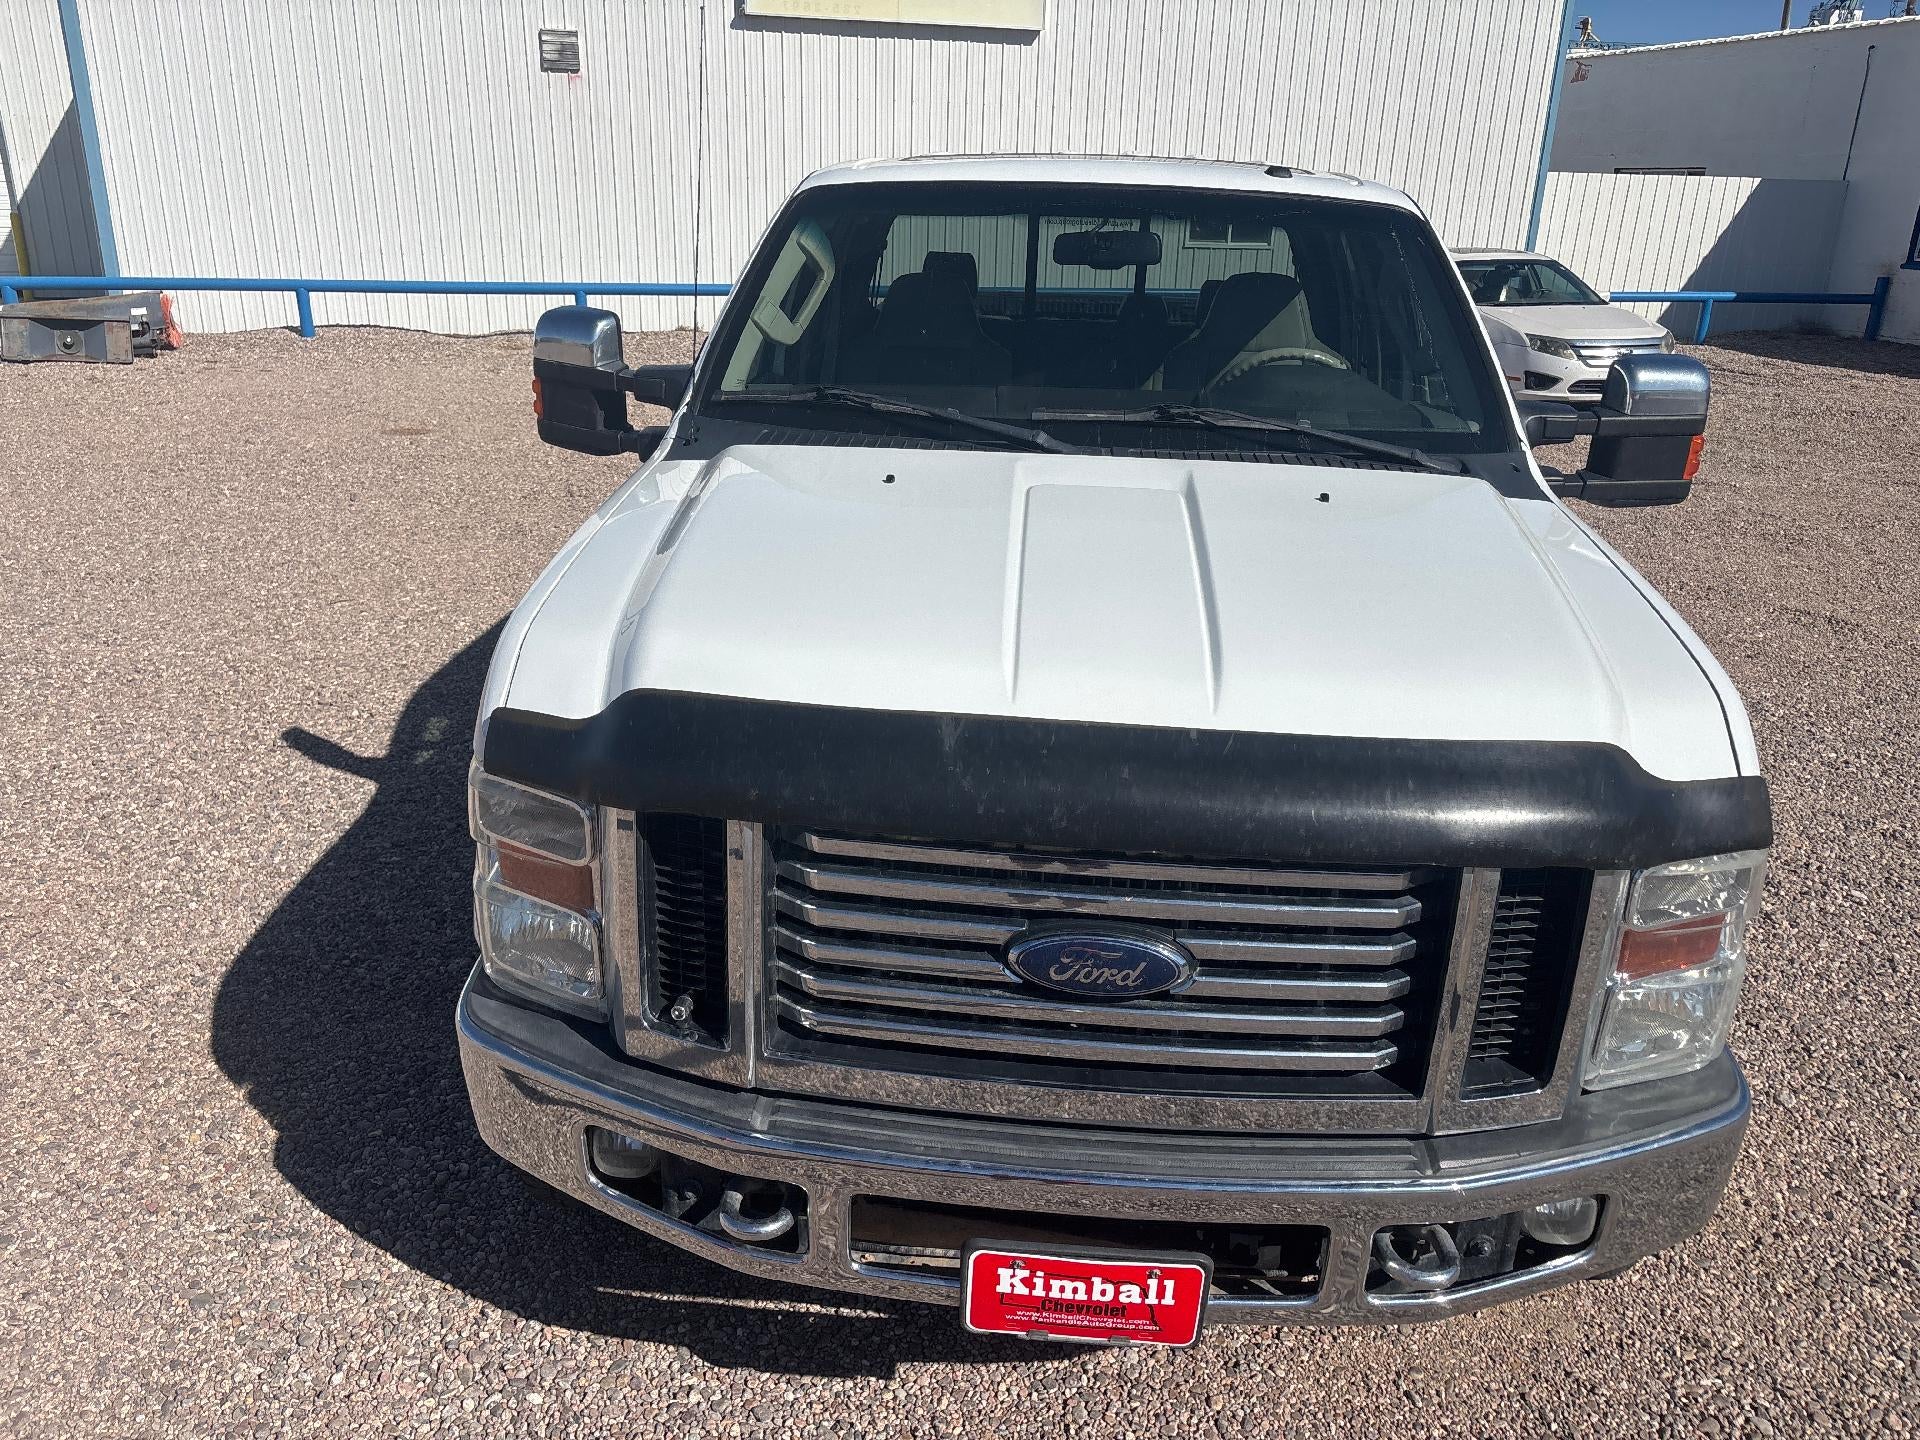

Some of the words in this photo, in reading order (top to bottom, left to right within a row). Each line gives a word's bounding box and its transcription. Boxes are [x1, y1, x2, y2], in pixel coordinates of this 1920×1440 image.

[1049, 946, 1149, 987] Ford
[996, 1267, 1175, 1306] Kimball
[1040, 1299, 1127, 1317] Chevrolet
[1005, 1314, 1160, 1331] www.PanhandleAutoGroup.com
[1016, 1310, 1150, 1325] www.KimballChevrolet.com
